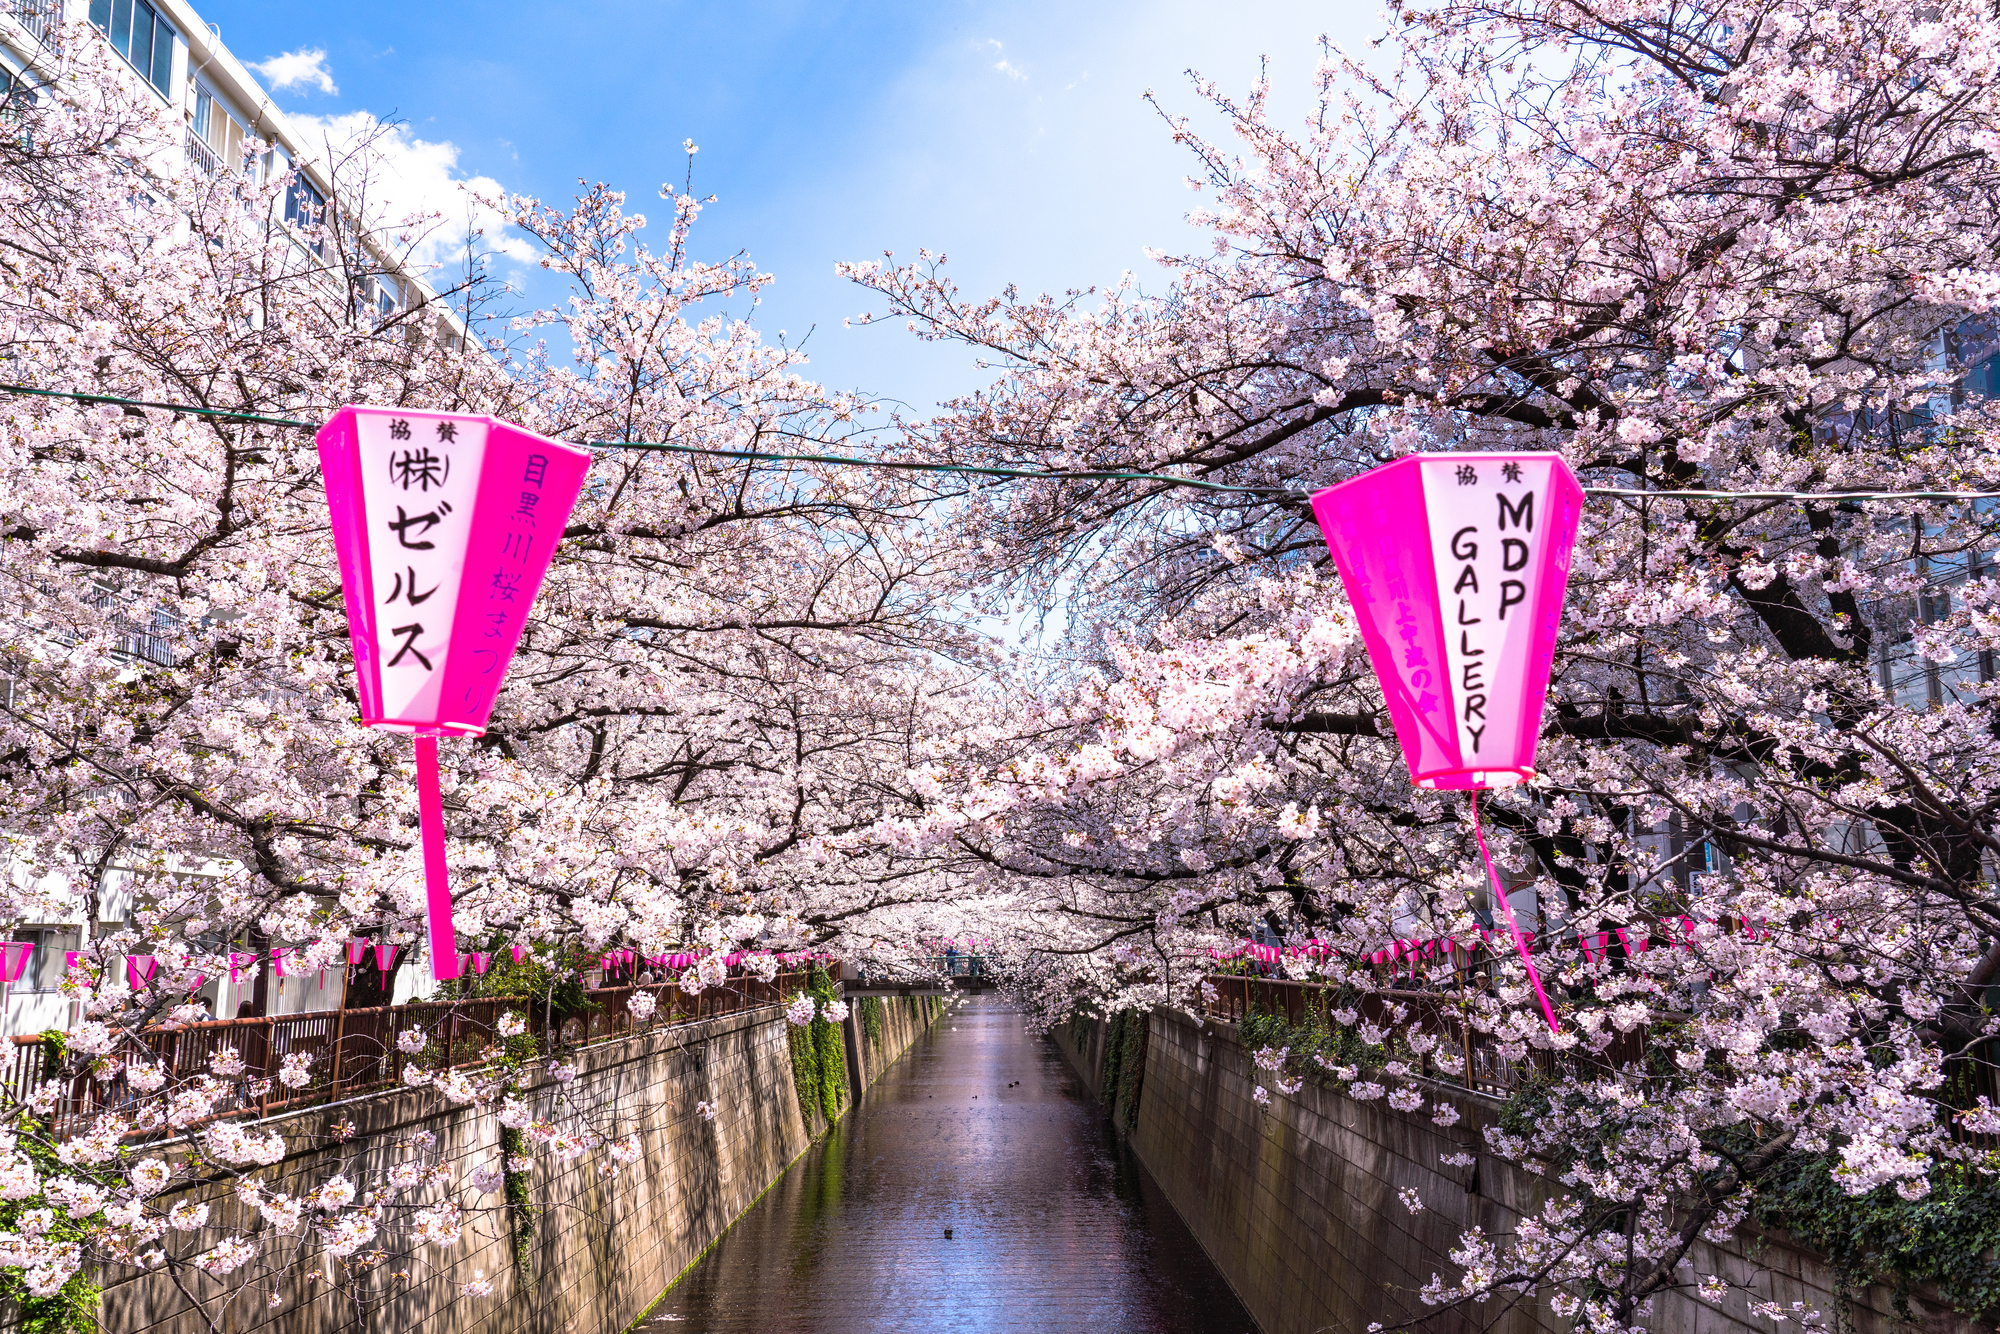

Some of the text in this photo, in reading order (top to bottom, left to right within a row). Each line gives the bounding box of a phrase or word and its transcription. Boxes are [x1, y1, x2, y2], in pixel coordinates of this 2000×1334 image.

[465, 453, 549, 714] 目黒川桜まつり
[1451, 526, 1487, 753] GALLERY
[1496, 491, 1534, 620] MDP
